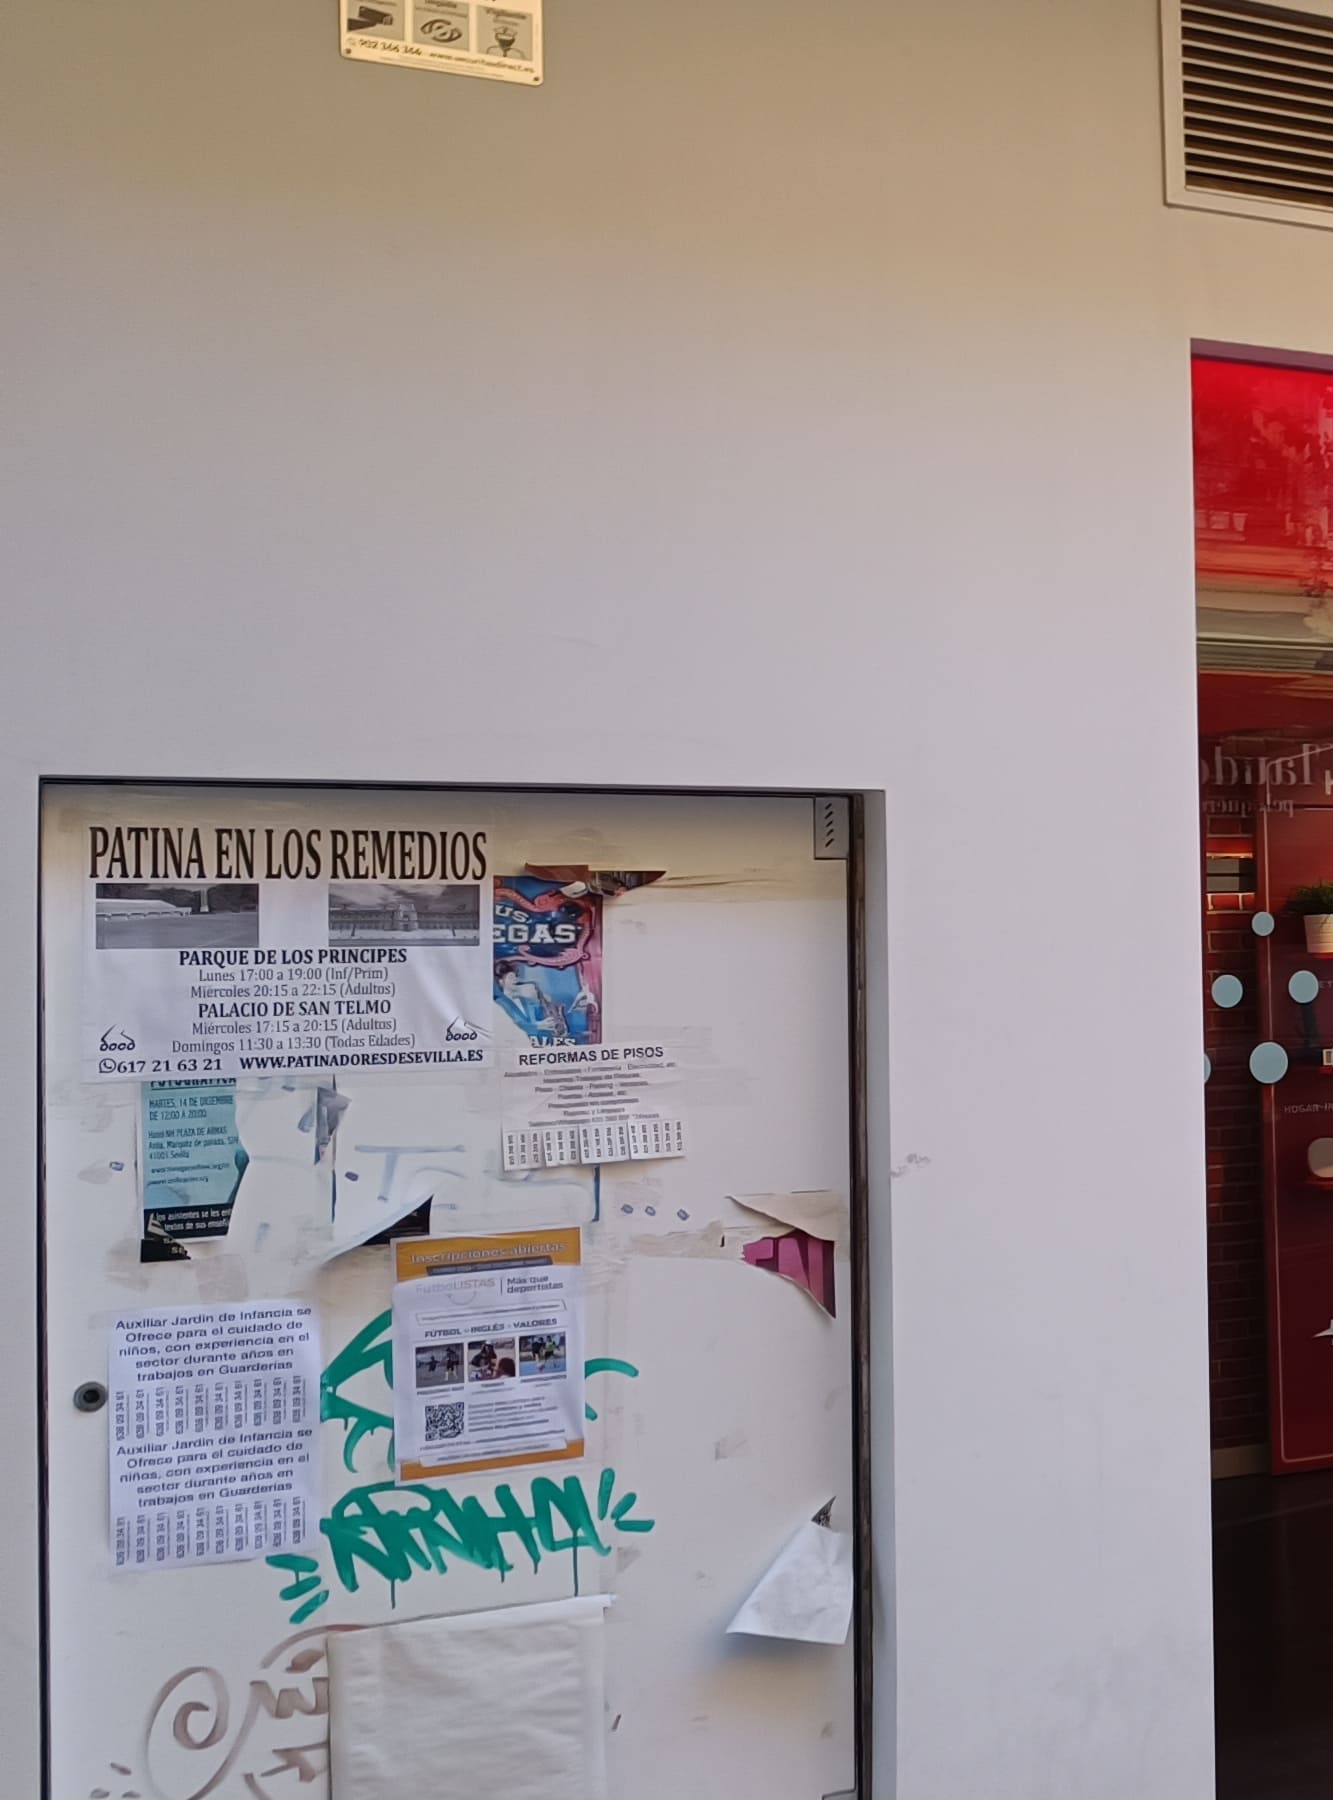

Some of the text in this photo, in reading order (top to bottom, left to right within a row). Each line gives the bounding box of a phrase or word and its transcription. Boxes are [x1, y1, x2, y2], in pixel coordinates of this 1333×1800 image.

[89, 827, 487, 881] PATINA EN LOS REMEDIOS
[179, 948, 408, 969] PARQUE DE LOS PRINCIPES
[199, 967, 389, 981] Lunes 17:00 a 19:00 (Inf/Prim)
[254, 984, 288, 997] 20:15
[291, 986, 298, 996] a
[302, 983, 336, 996] 22:15
[340, 982, 396, 996] (Adultos)
[198, 1000, 391, 1018] PALACIO DE SAN TELMO
[192, 1018, 397, 1035] Miércoles 17:15 a 20:15 (Adultos)
[172, 1033, 415, 1055] Domingos 11:30 a 13:30 (Todas Edades)
[117, 1049, 484, 1074] 617 21 63 21 WWW.PATINADORESDESEVILLA.ES
[519, 1046, 664, 1066] REFORMAS DE PISOS
[189, 1097, 198, 1107] DE
[149, 1110, 158, 1121] DE
[197, 1127, 205, 1136] DE
[410, 1241, 568, 1265] Inscripciones abiertas
[506, 1280, 564, 1295] deportistas
[507, 1275, 527, 1285] Más
[115, 1318, 168, 1331] Auxiliar
[218, 1312, 236, 1322] de
[240, 1307, 293, 1320] Infancia
[297, 1308, 312, 1316] se
[424, 1318, 557, 1338] FÚTBOL INGLÉS VALORES
[126, 1320, 303, 1343] Ofrece para el cuidado de
[119, 1332, 310, 1358] niños, con experiencia en el
[135, 1347, 294, 1369] sector durante años en
[137, 1369, 193, 1383] trabajos
[197, 1368, 214, 1377] en
[116, 1443, 168, 1457] Auxiliar
[218, 1435, 236, 1445] de
[240, 1430, 293, 1443] Infancia
[297, 1429, 312, 1437] se
[126, 1442, 303, 1469] Ofrece para el cuidado de
[119, 1453, 310, 1483] niños, con experiencia en el
[136, 1469, 294, 1495] sector durante años en
[138, 1494, 194, 1508] trabajos
[198, 1491, 215, 1500] en
